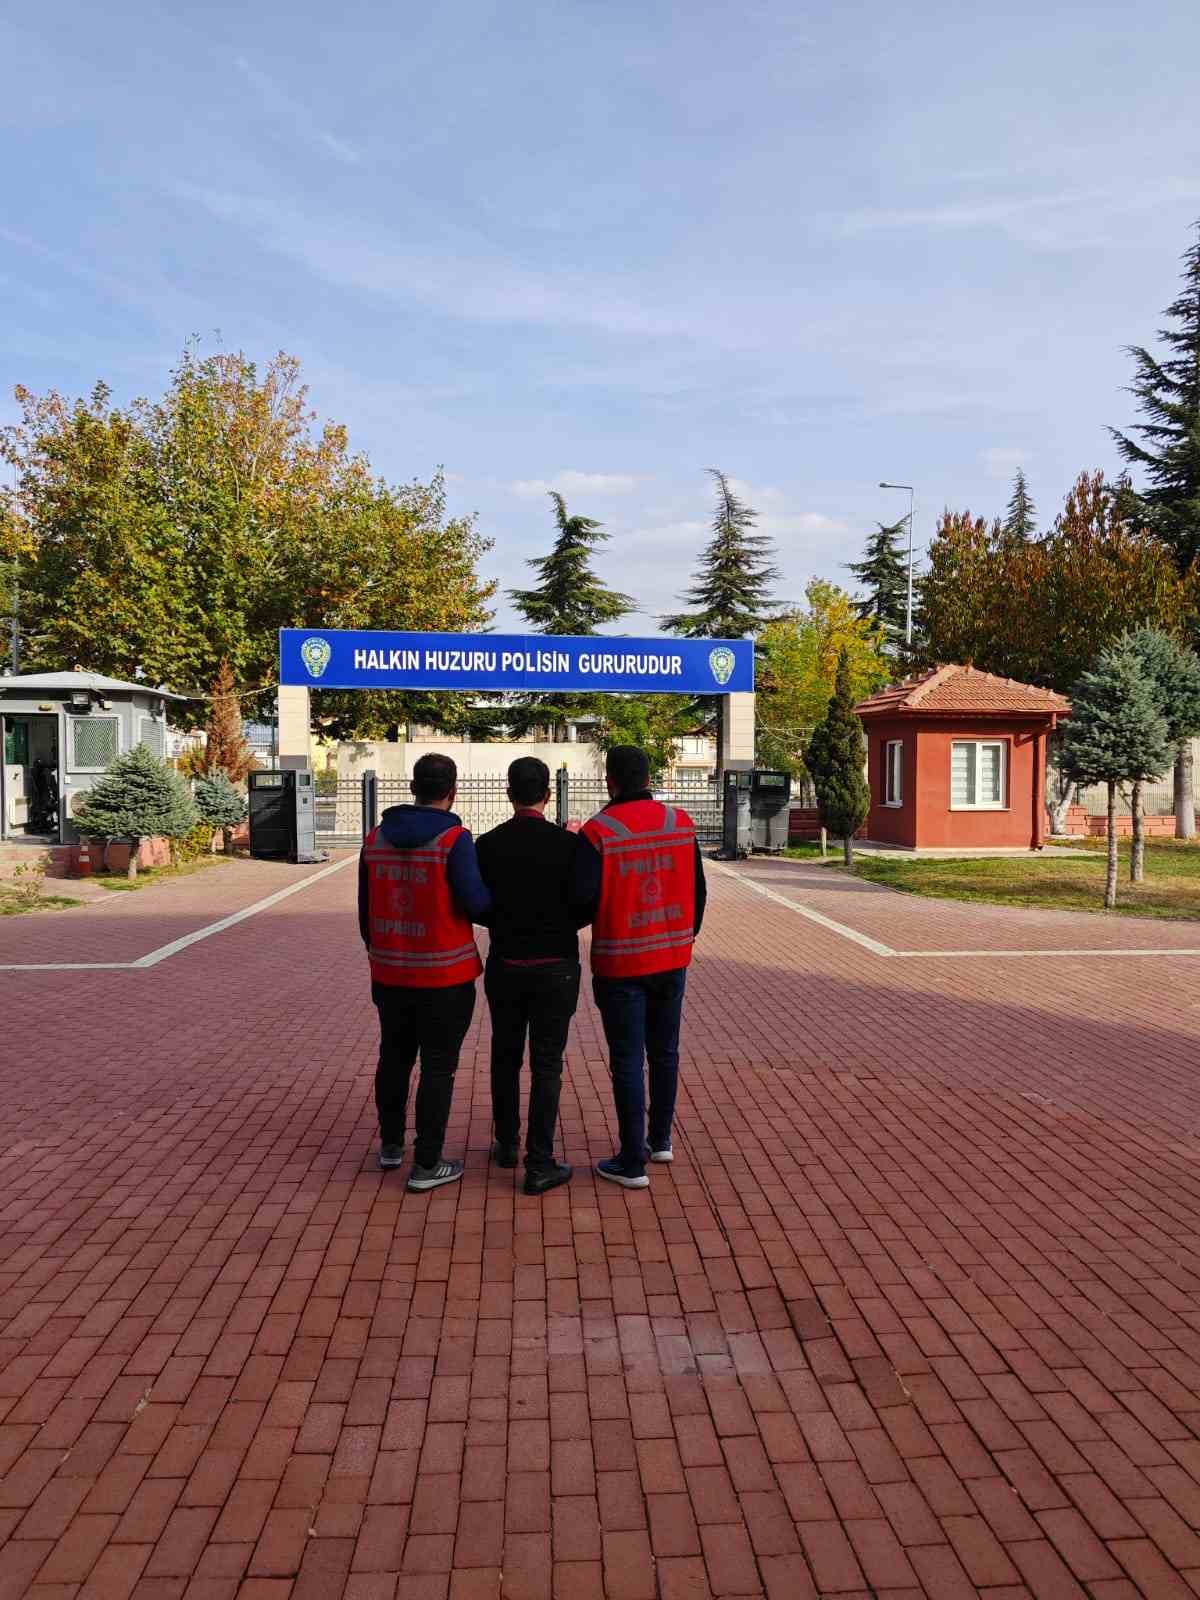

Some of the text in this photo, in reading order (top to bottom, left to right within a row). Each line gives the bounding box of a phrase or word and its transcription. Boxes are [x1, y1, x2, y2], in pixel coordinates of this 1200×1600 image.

[355, 650, 682, 674] HALKIN HUZURU POLİSİN GURURUDUR
